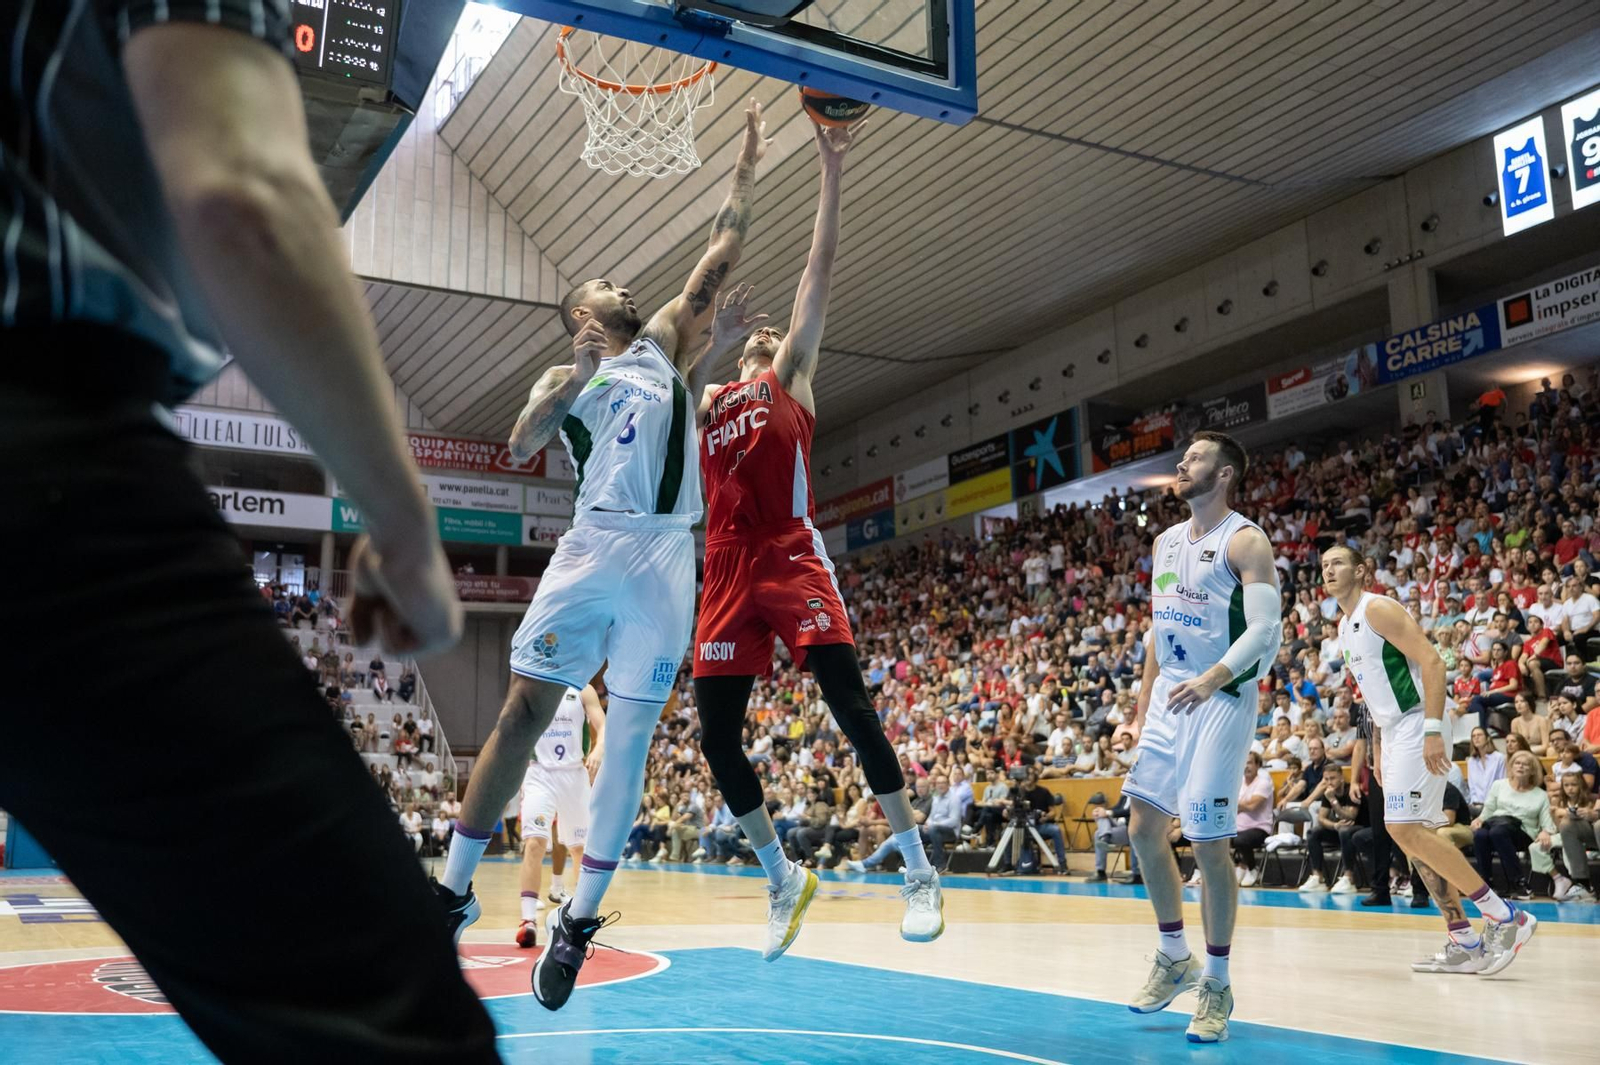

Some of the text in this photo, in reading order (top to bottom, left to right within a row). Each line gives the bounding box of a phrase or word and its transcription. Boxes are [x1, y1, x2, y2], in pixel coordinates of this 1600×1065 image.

[295, 24, 315, 52] 0
[1582, 136, 1600, 166] 9
[1514, 165, 1531, 195] 7
[1385, 312, 1481, 355] CALSINA
[193, 417, 245, 444] LLEAL
[616, 412, 636, 445] 6
[408, 447, 492, 464] ESPORTIVES
[439, 482, 510, 497] www.panella.cat
[1175, 584, 1209, 602] Unicaja
[1153, 605, 1203, 627] málaga
[699, 641, 736, 661] YOSOY
[1167, 634, 1187, 661] 4
[652, 668, 674, 687] lag
[542, 729, 573, 739] málaga
[554, 744, 566, 761] 9
